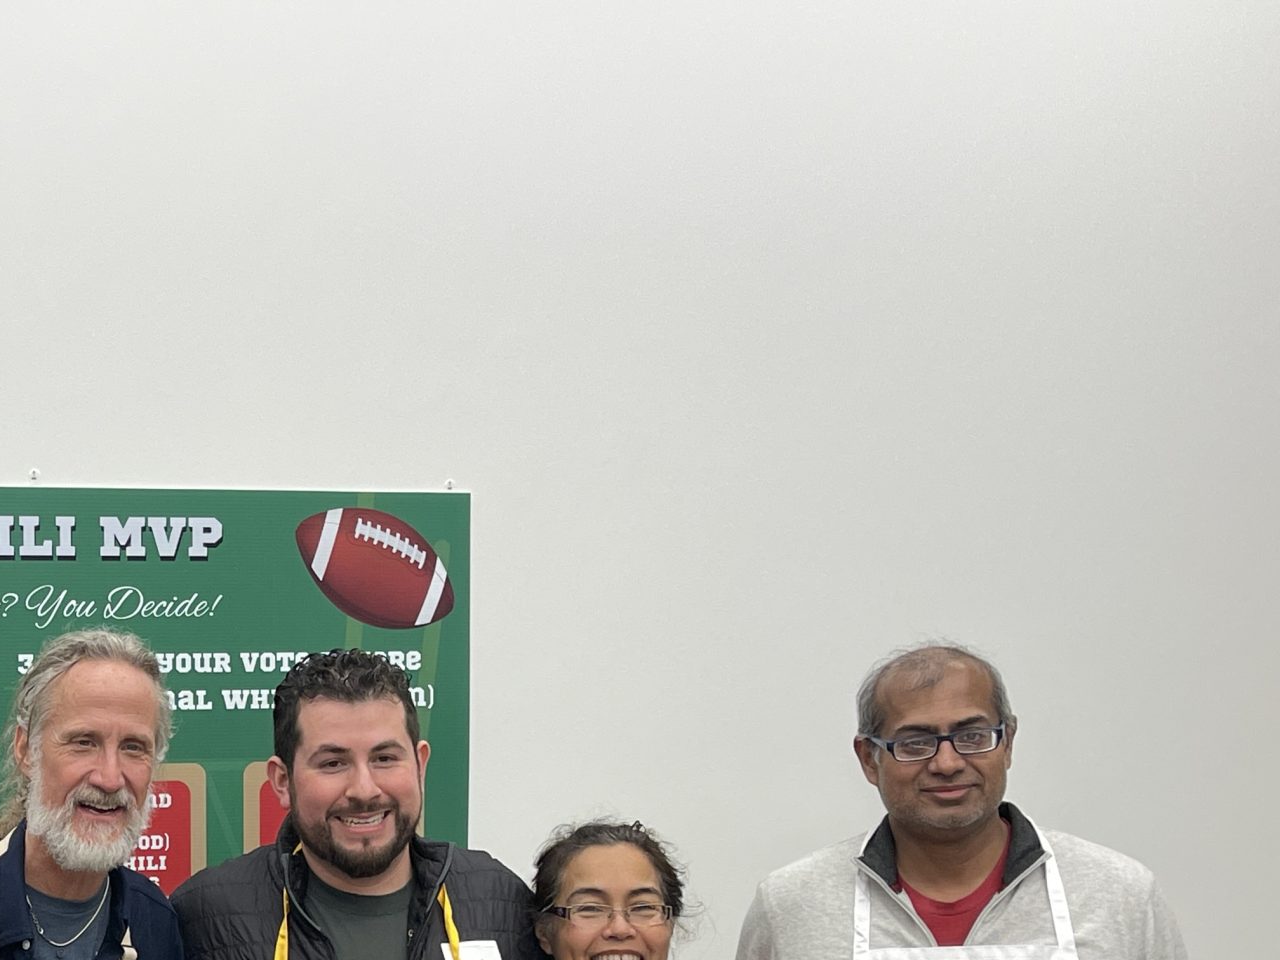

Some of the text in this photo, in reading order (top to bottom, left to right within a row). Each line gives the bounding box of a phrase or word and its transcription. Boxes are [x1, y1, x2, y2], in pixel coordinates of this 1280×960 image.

[99, 516, 223, 561] MVP
[25, 584, 98, 628] You
[103, 585, 223, 620] Decide!
[17, 653, 34, 675] 3
[124, 855, 167, 872] HILI
